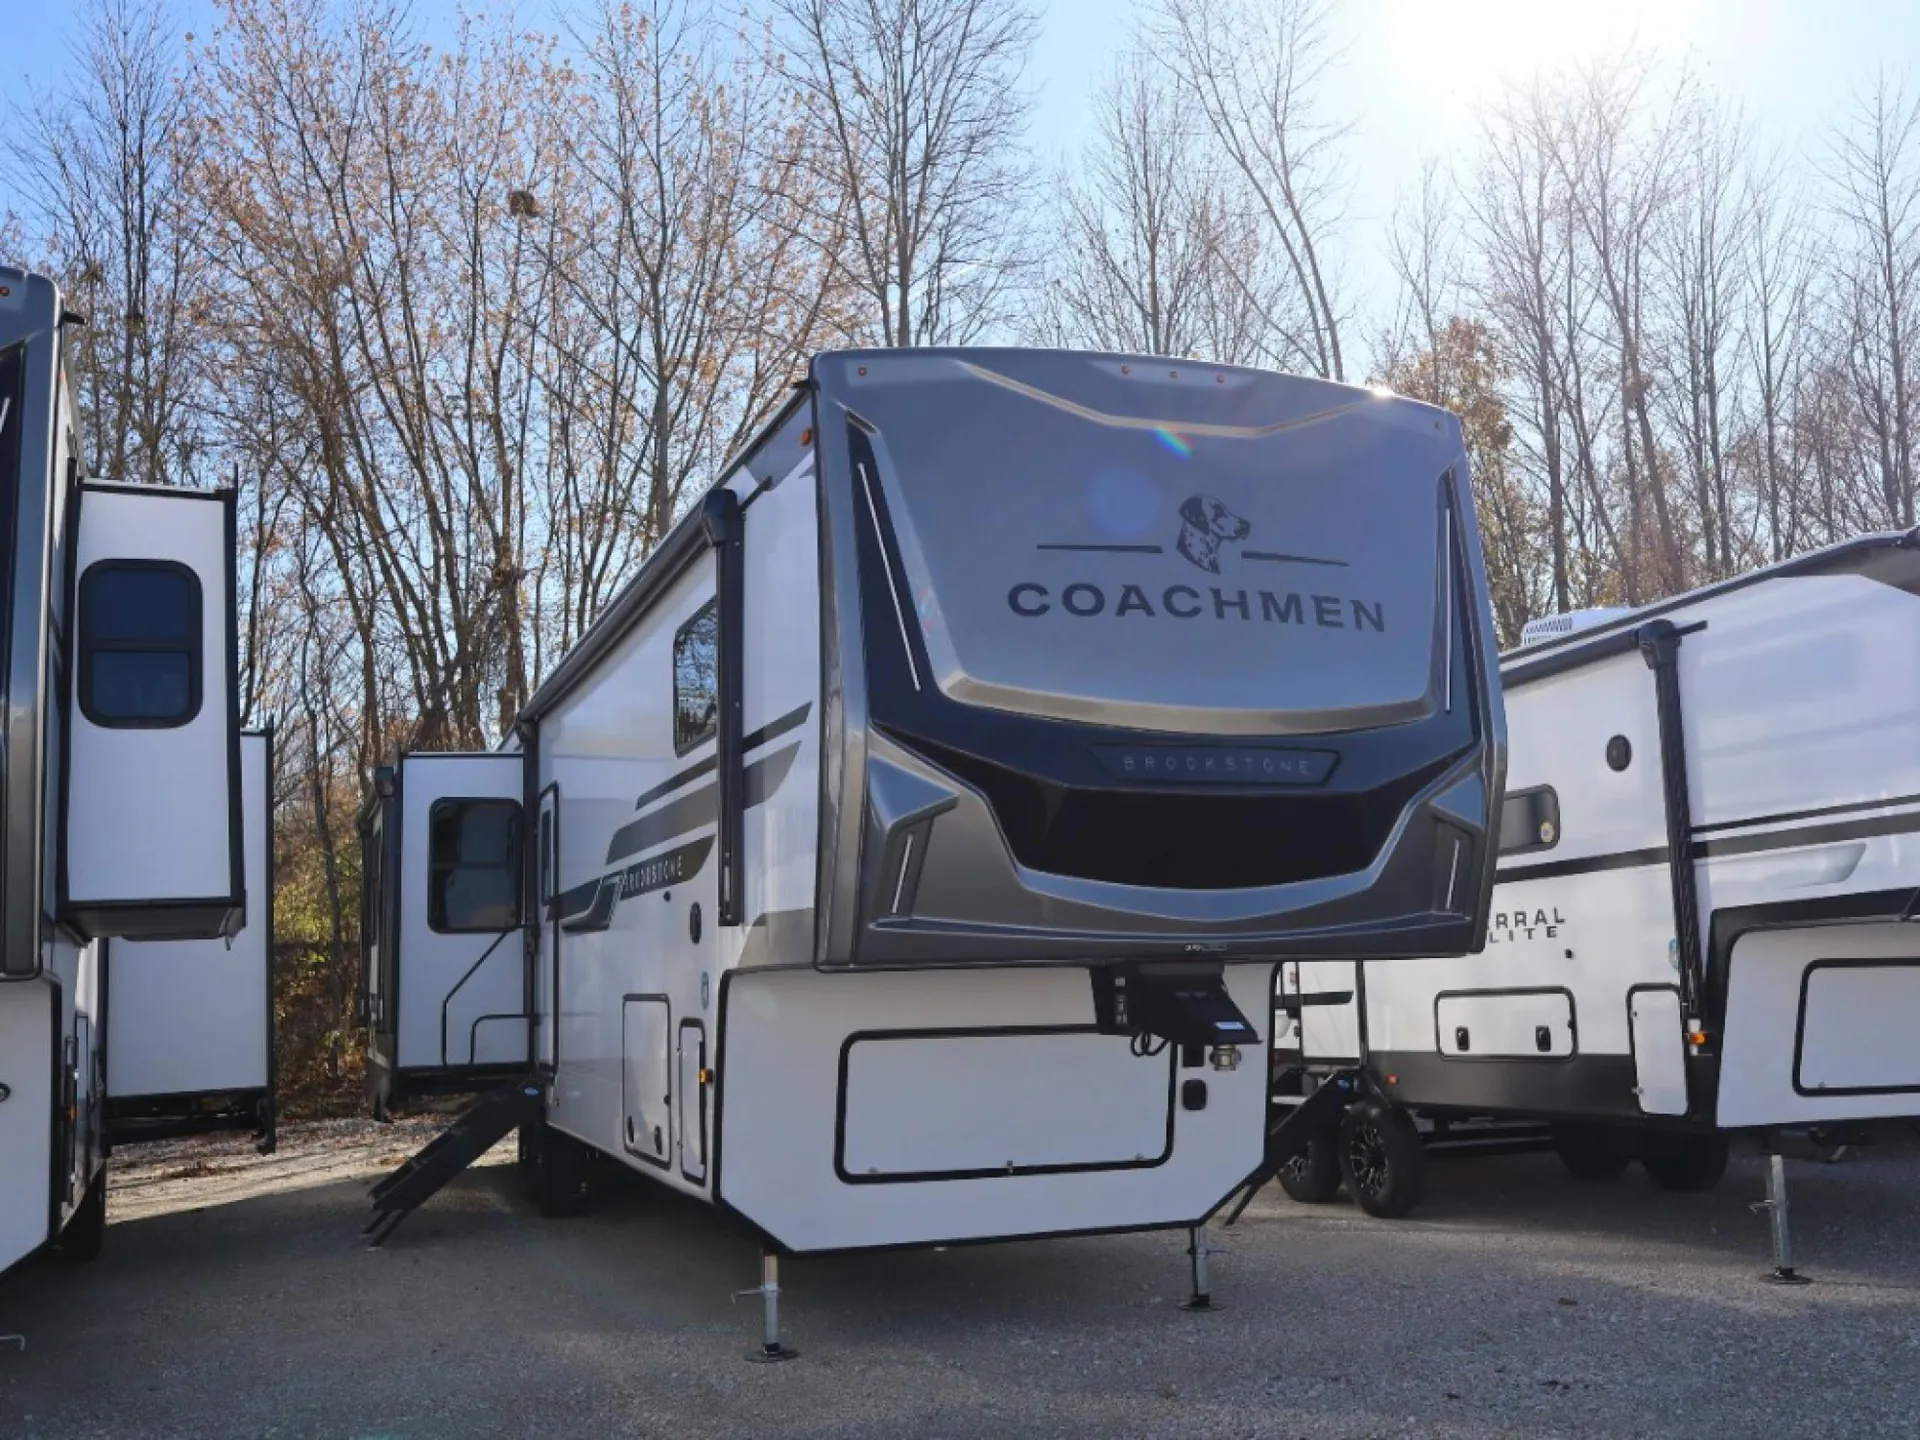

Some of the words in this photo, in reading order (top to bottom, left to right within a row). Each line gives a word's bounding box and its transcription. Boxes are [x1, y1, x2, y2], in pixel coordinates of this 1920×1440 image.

[1008, 582, 1386, 633] COACHMEN
[1123, 756, 1310, 775] BROOKSTONE
[1495, 907, 1567, 930] RRAL
[1489, 926, 1558, 943] LITE
